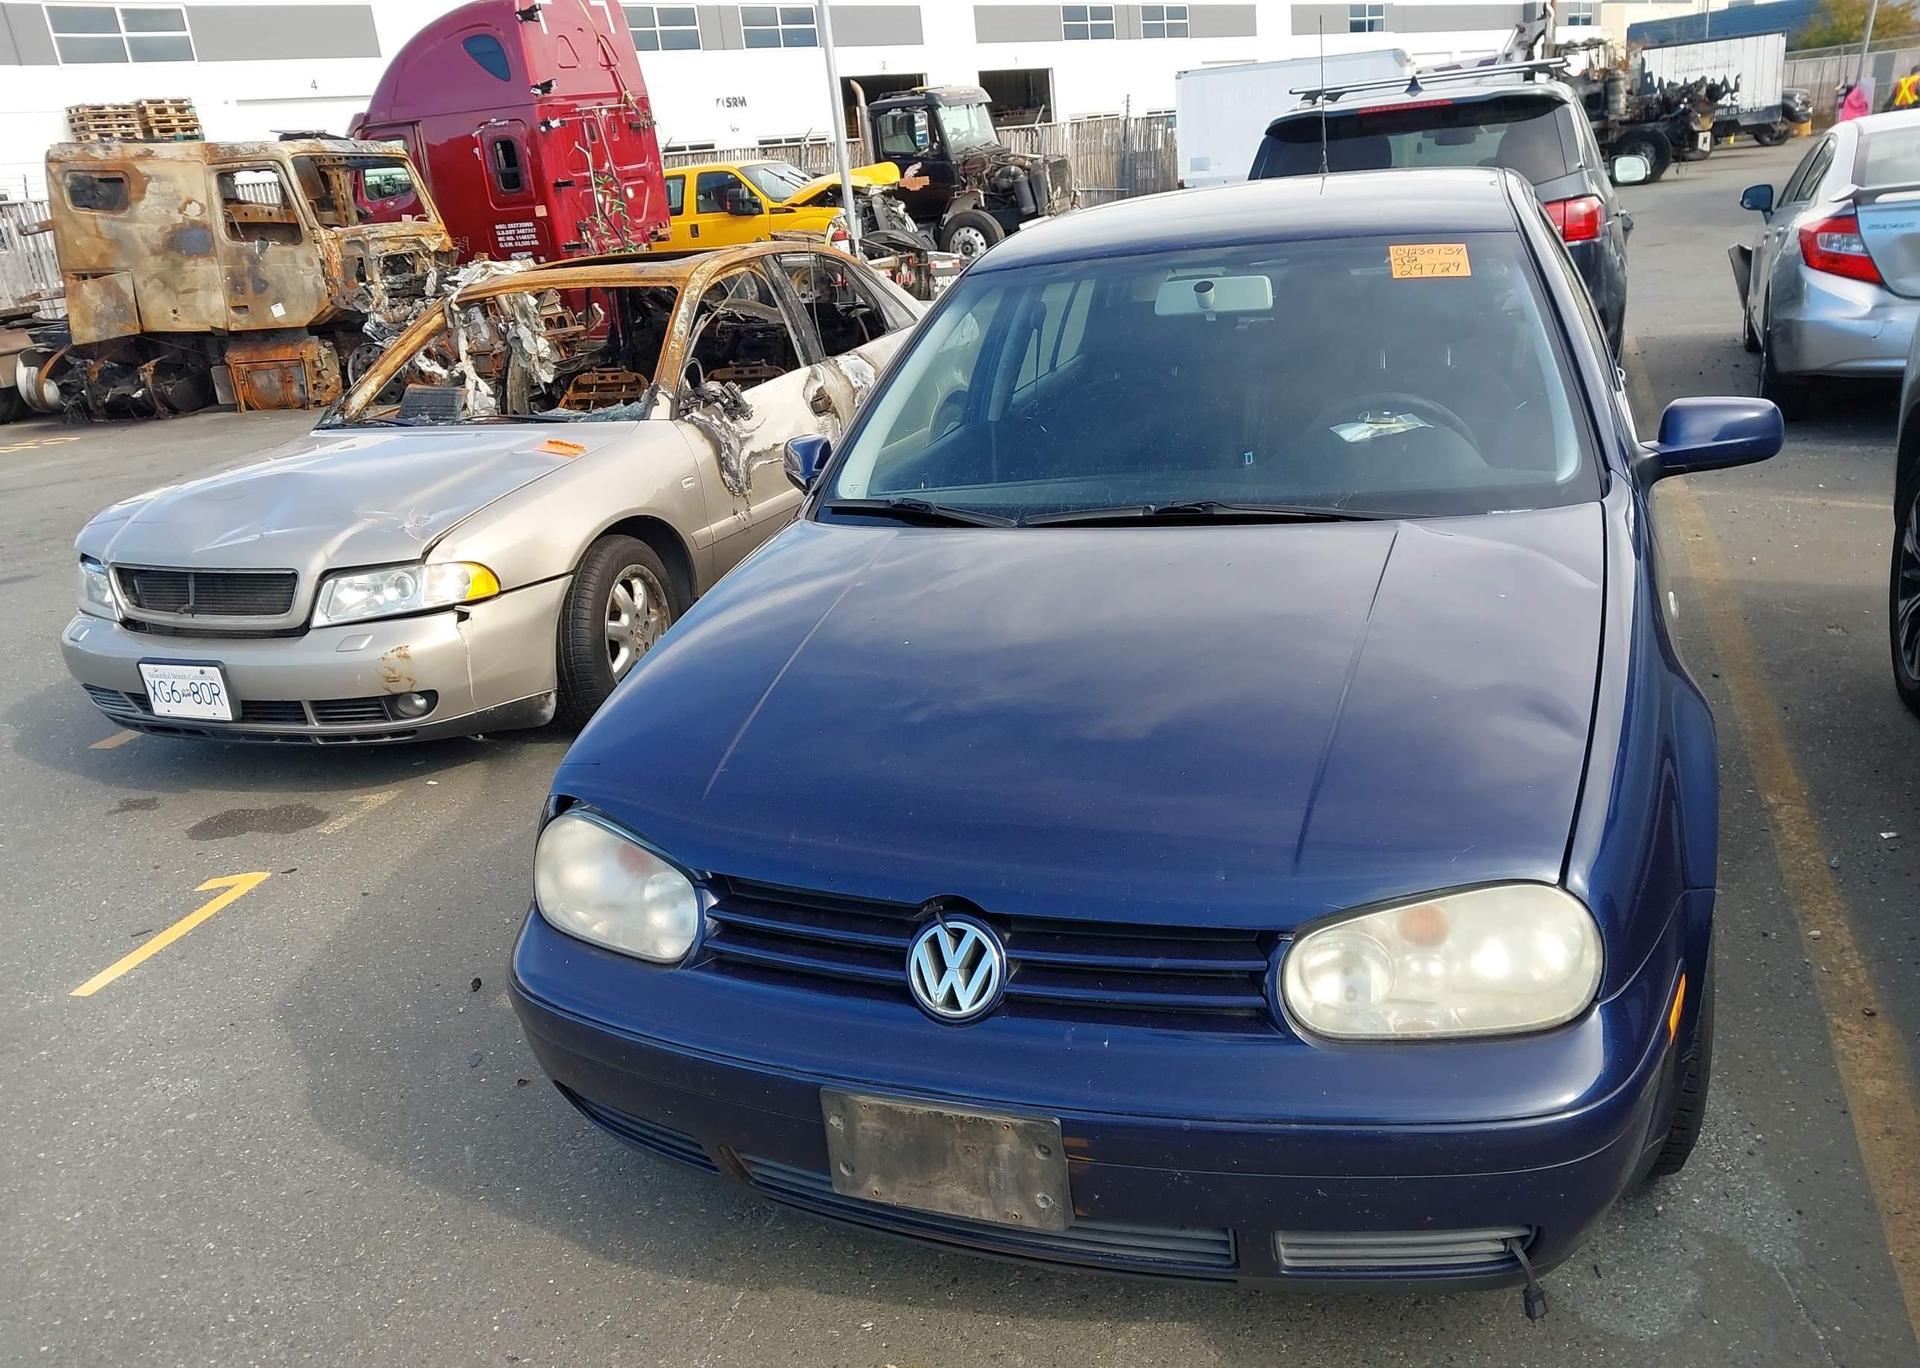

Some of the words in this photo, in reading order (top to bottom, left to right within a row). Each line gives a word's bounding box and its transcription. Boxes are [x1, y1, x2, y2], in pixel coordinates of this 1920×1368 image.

[310, 79, 318, 91] 4
[1400, 261, 1461, 276] 29729
[147, 679, 182, 703] XG6
[910, 921, 1000, 1018] VW
